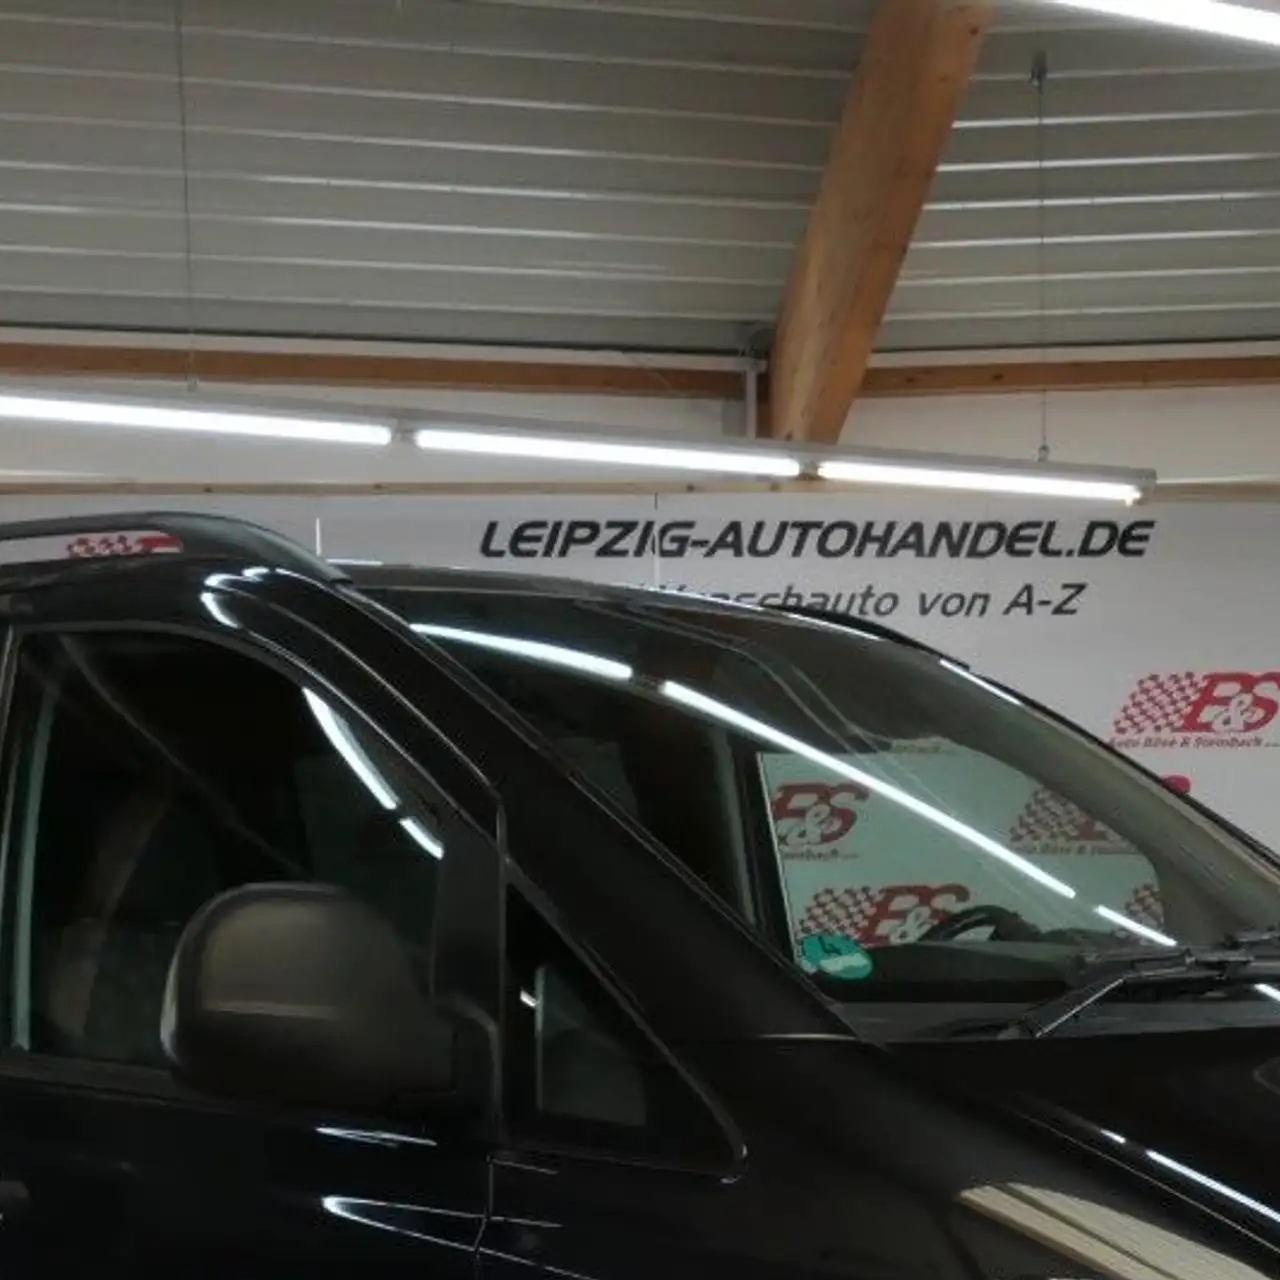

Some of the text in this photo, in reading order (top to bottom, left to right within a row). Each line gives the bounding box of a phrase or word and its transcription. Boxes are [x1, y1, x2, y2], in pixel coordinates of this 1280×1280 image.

[479, 520, 1156, 559] LEIPZIG-AUTOHANDEL.DE
[919, 592, 991, 617] von
[1002, 582, 1088, 616] A-Z
